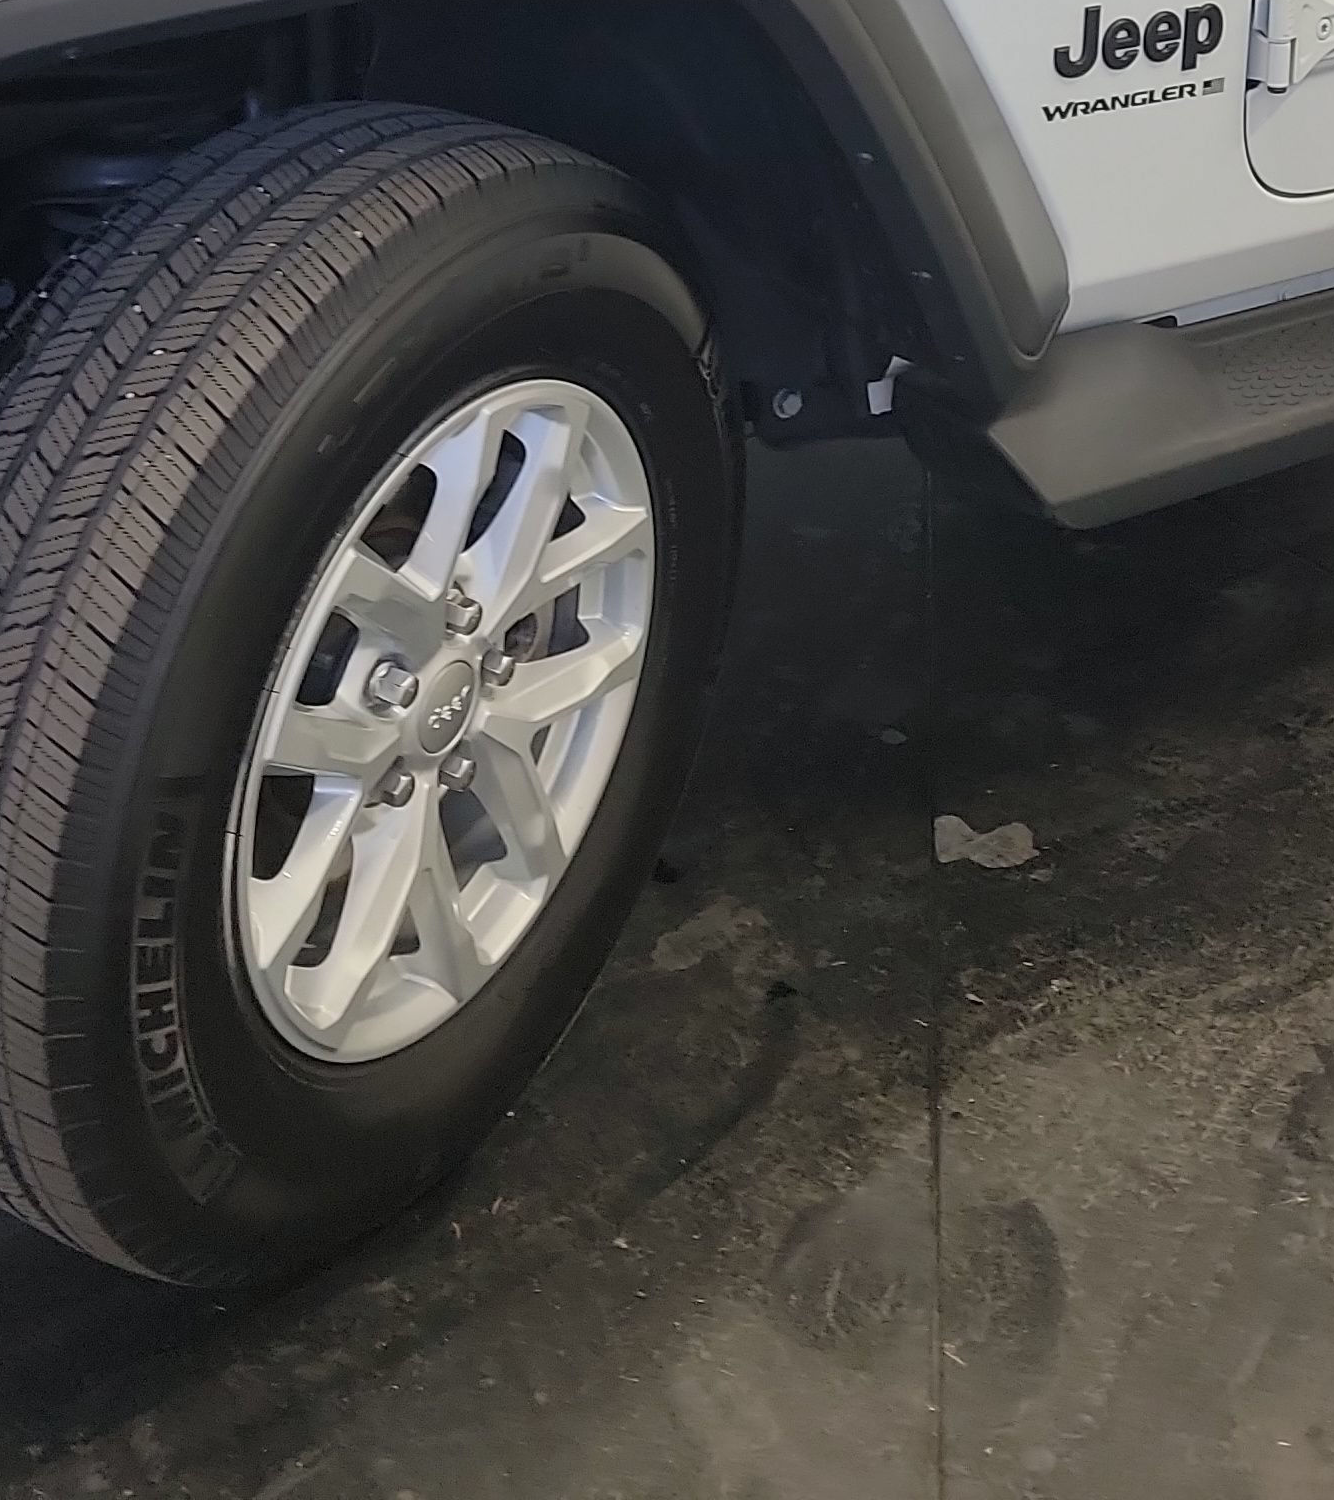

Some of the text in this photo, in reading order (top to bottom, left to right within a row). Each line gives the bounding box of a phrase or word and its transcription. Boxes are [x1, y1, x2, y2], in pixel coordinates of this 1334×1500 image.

[1053, 2, 1224, 78] Jeep
[1042, 83, 1197, 121] WRANGLER
[135, 811, 201, 1141] MICHELIN
